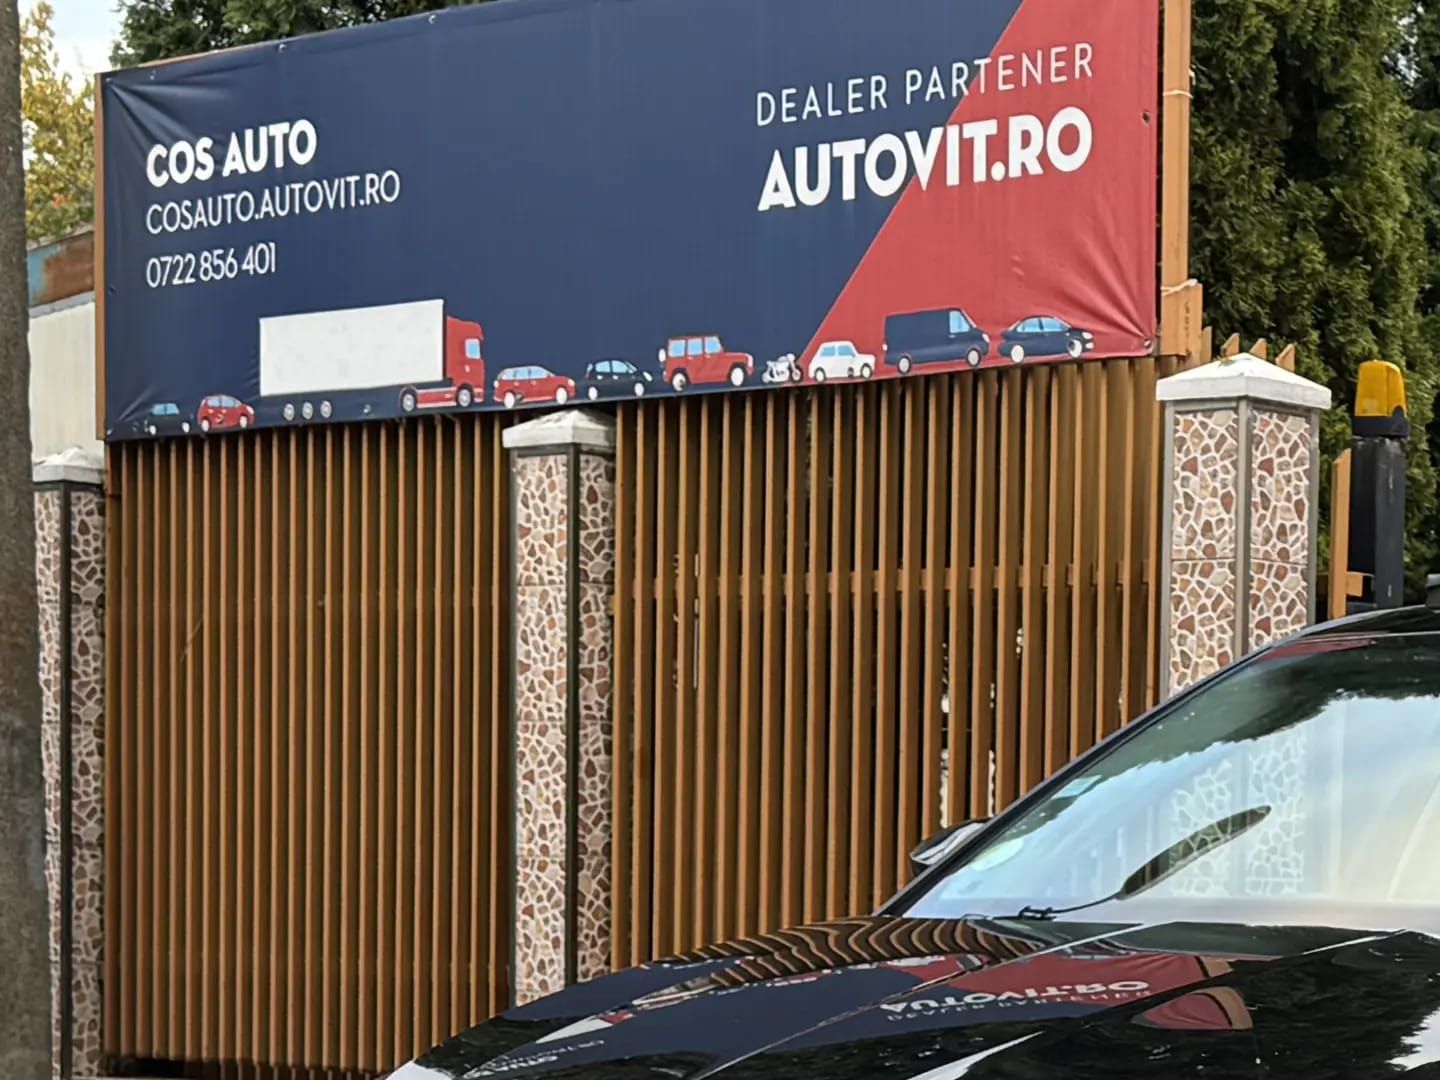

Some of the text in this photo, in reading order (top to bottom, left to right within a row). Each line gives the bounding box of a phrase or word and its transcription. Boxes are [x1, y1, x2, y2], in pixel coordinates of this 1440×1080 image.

[757, 43, 1093, 127] DEALER PARTENER
[146, 119, 317, 187] COS AUTO
[757, 106, 1093, 211] AUTOVIT.RO
[146, 170, 400, 234] COSAUTO.AUTOVIT.RO
[146, 242, 276, 288] 0722 856 401
